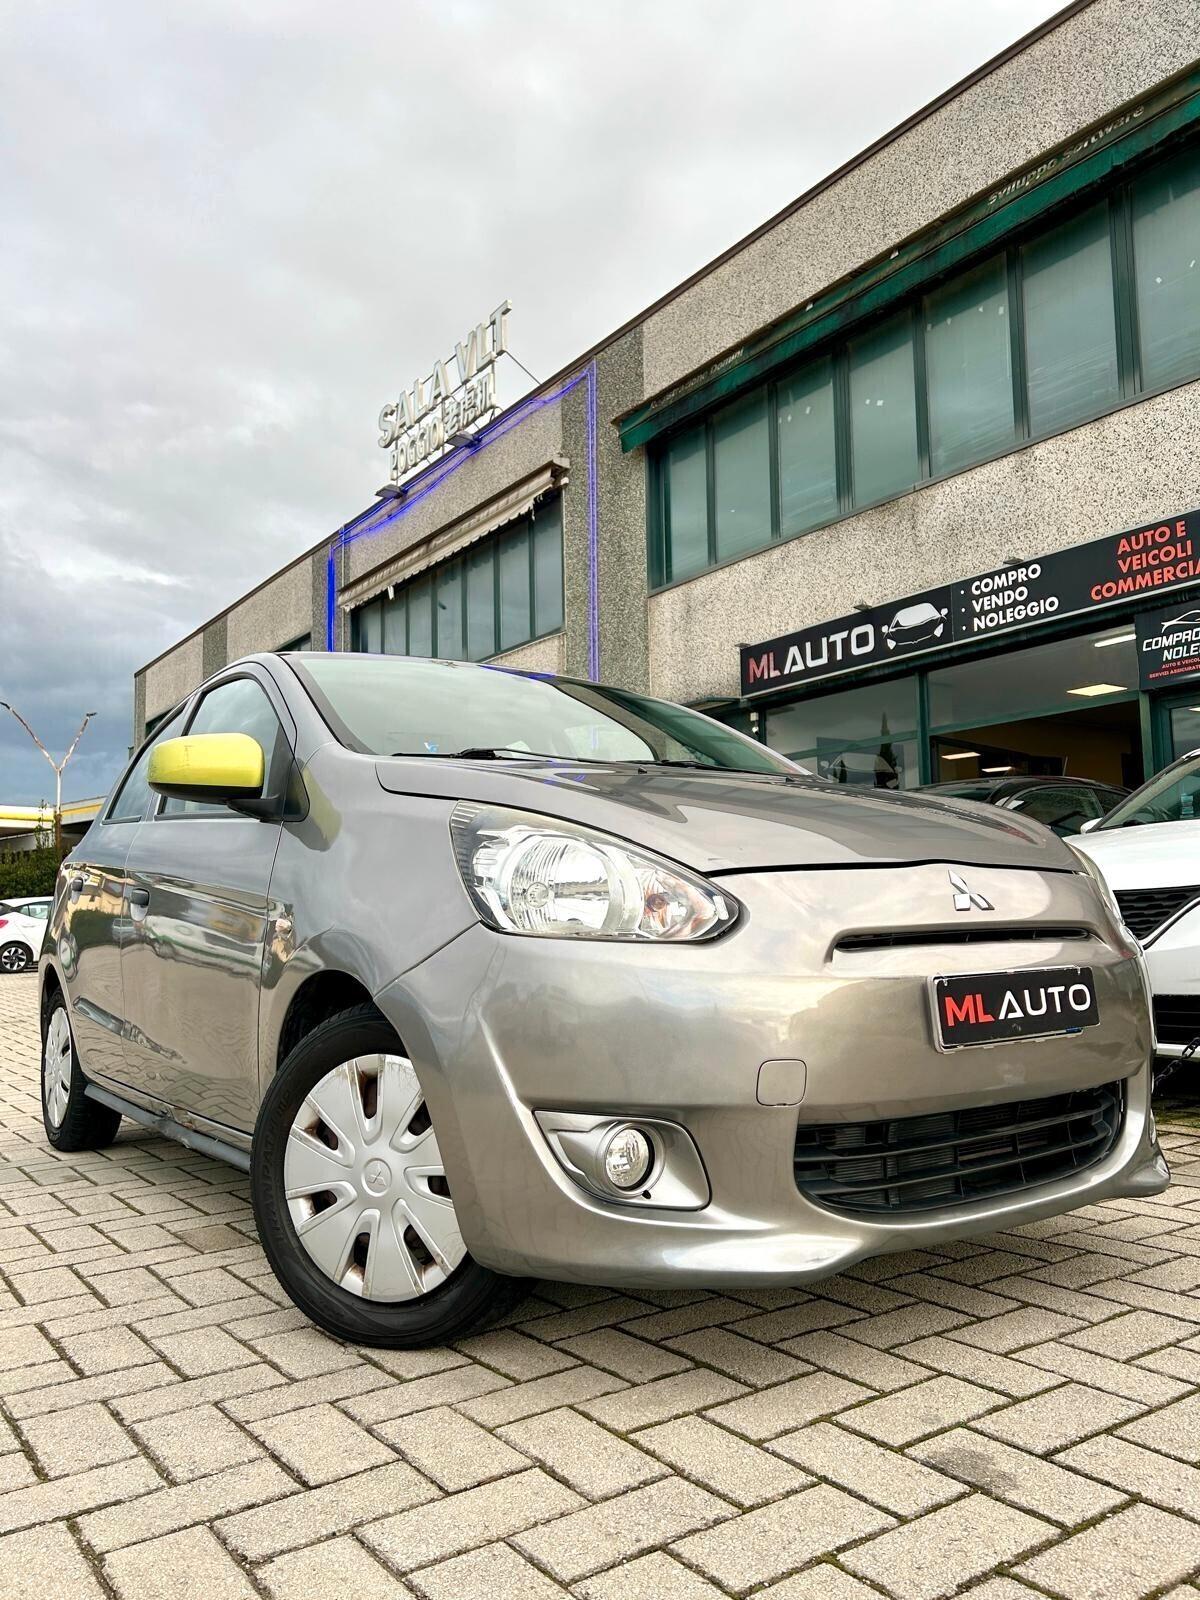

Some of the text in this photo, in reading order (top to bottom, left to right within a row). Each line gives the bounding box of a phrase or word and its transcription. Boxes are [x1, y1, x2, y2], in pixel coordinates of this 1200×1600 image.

[378, 300, 512, 449] SALA VLT
[389, 416, 444, 482] POGGIO
[1117, 520, 1187, 555] AUTO E
[1117, 539, 1193, 574] VEICOLI
[971, 563, 1042, 596] COMPRO
[972, 586, 1029, 613] VENDO
[973, 596, 1060, 632] NOLEGGIO
[1162, 643, 1200, 662] NOLE
